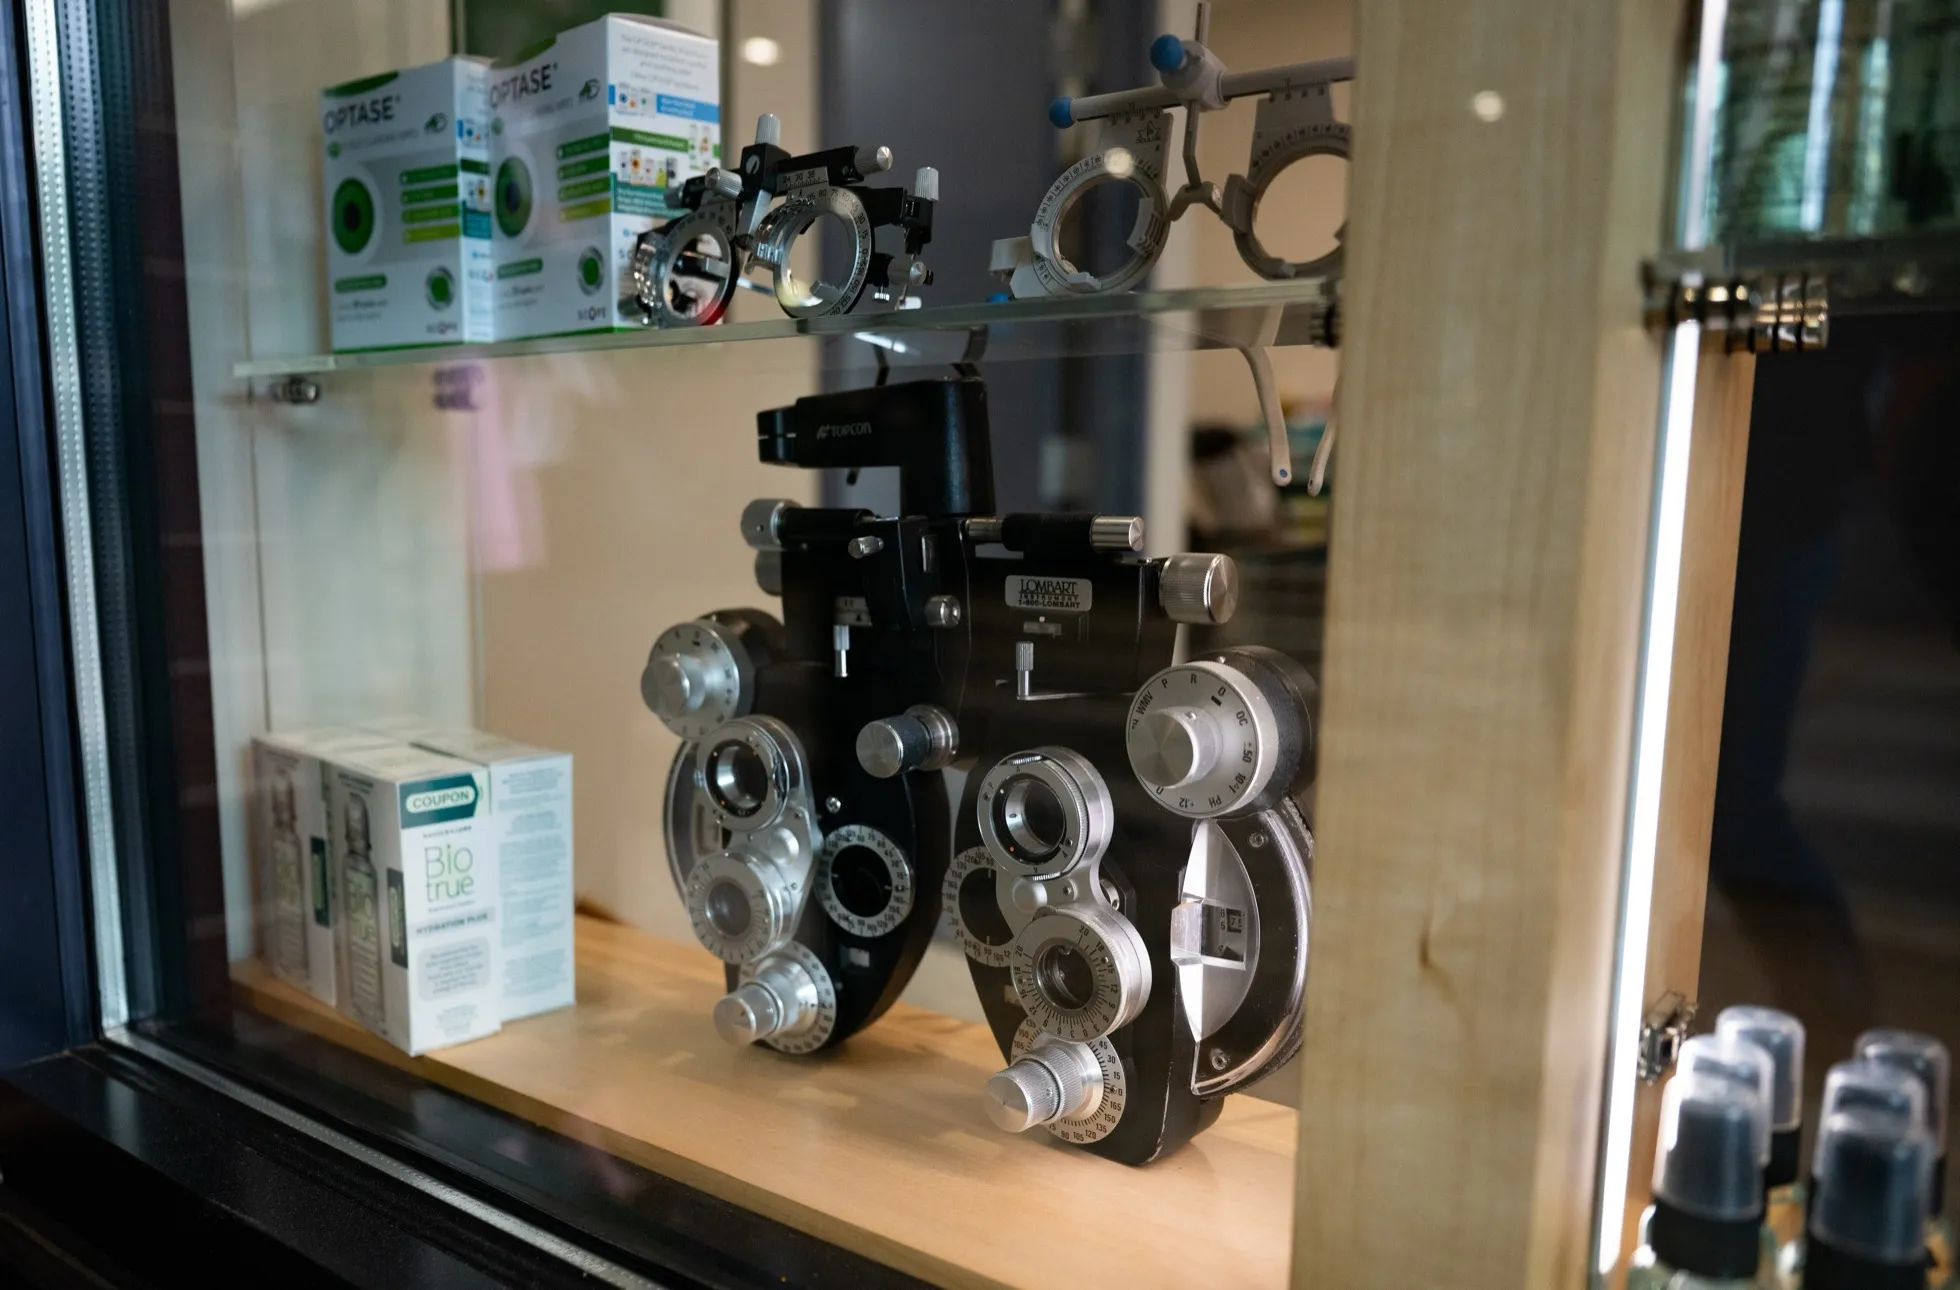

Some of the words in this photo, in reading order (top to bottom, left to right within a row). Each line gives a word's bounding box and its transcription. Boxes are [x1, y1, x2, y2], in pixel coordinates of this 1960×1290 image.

[831, 422, 872, 438] TOPCON
[1020, 578, 1077, 595] LOMBART
[412, 789, 470, 809] COUPON
[424, 844, 474, 880] Bio
[425, 876, 475, 903] true
[1078, 925, 1090, 937] 20
[1098, 1040, 1108, 1050] 45
[1107, 1055, 1116, 1064] 30
[1113, 1071, 1121, 1080] 15
[1110, 1101, 1122, 1111] 165
[1104, 1113, 1116, 1124] 150
[1096, 1122, 1107, 1133] 135
[1060, 1130, 1070, 1140] 90
[1073, 1131, 1085, 1142] 105
[1085, 1129, 1097, 1140] 120
